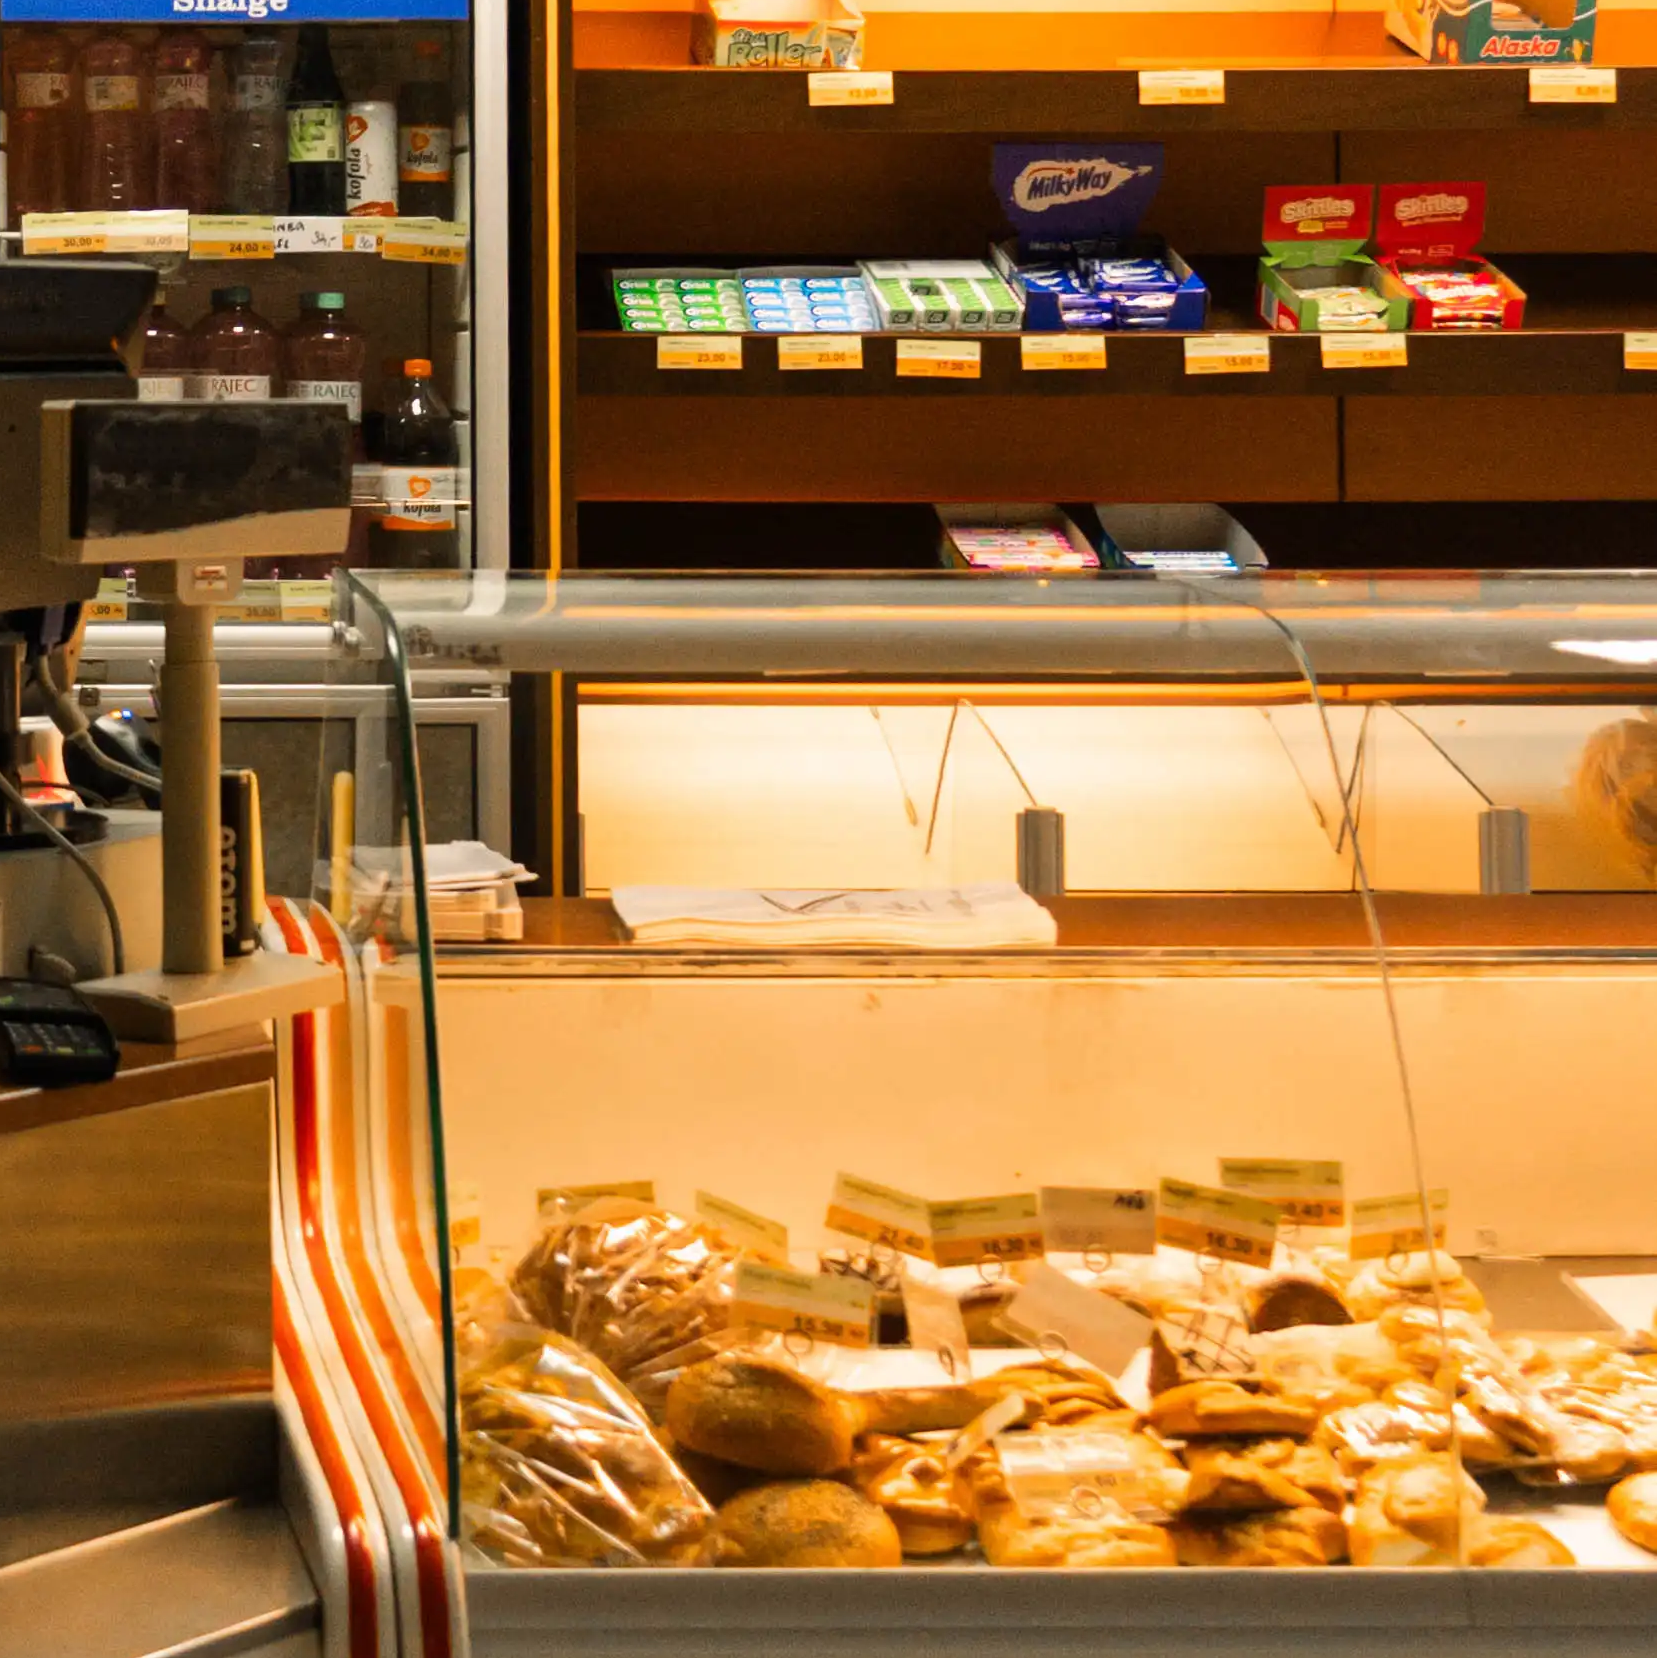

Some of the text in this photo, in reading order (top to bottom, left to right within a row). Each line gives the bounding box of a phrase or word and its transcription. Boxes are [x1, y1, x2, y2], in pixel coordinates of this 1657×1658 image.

[1480, 35, 1561, 59] Alaska
[347, 147, 366, 200] kofola
[1027, 166, 1113, 200] Milky Way
[210, 378, 258, 395] RAJEC
[313, 383, 359, 400] RAJEC
